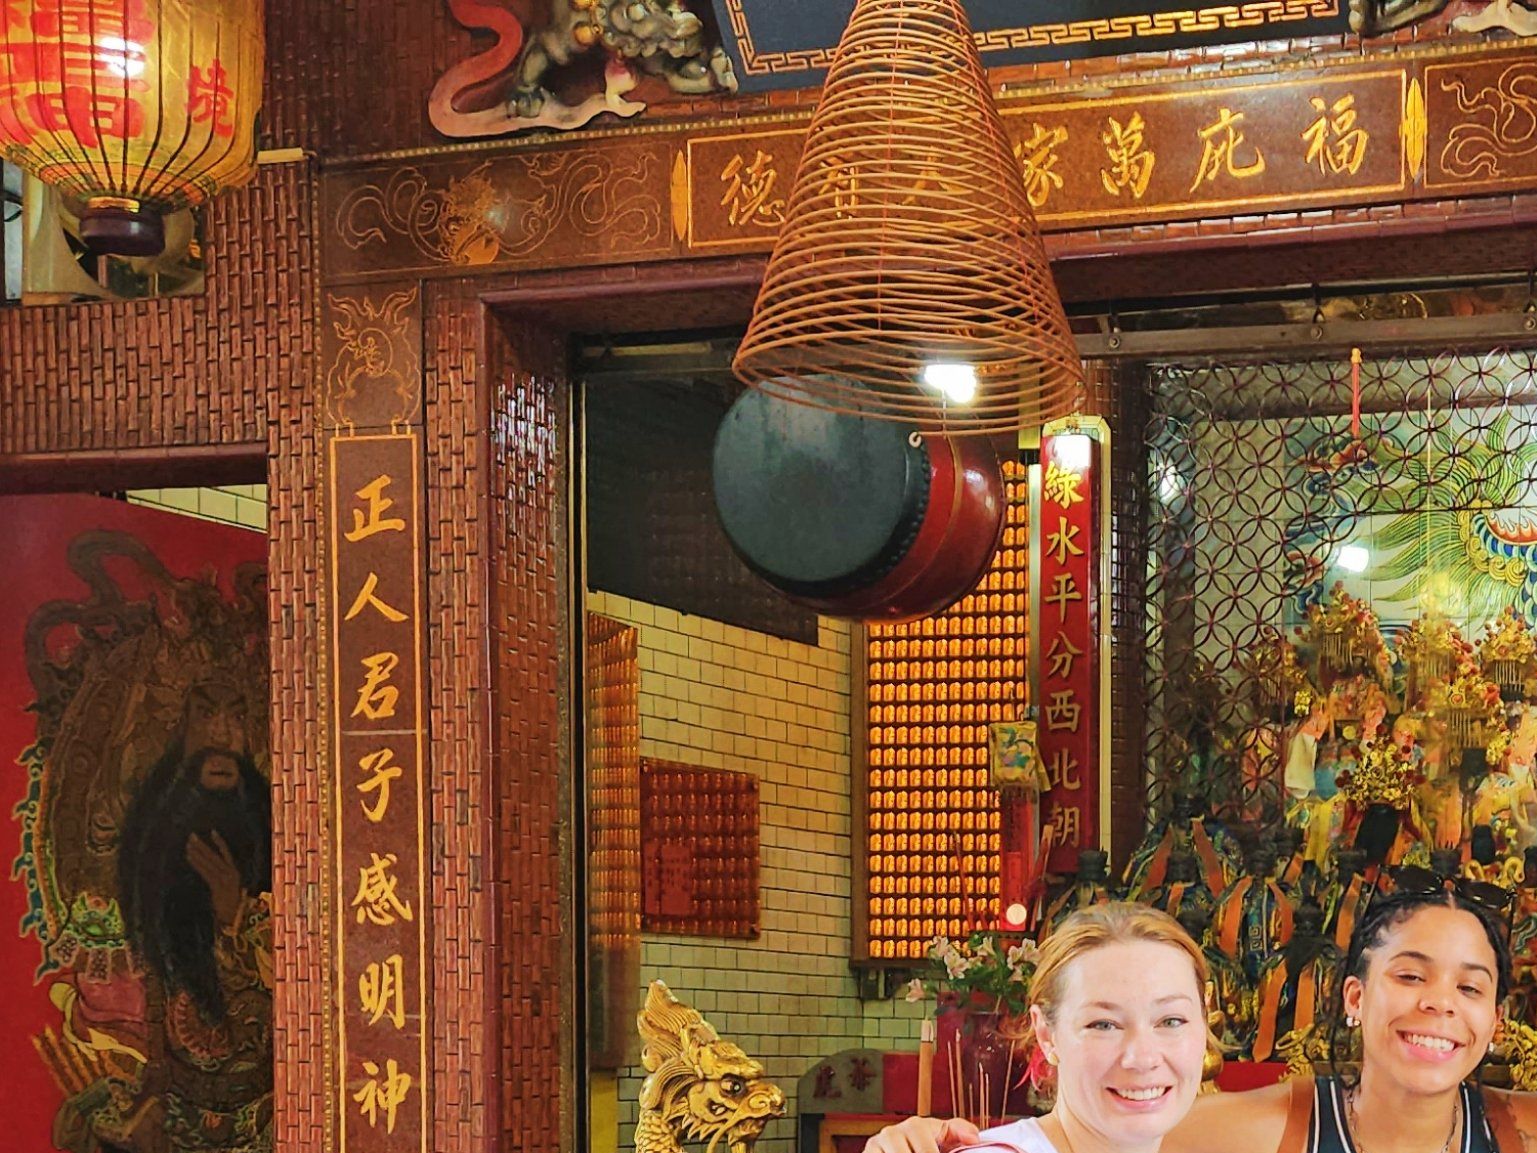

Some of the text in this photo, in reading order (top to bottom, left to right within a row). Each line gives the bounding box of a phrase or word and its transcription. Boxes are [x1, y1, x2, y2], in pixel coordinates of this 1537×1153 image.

[343, 474, 413, 1135] 正人君子感明神
[1043, 458, 1085, 848] 綠水平分西北朝
